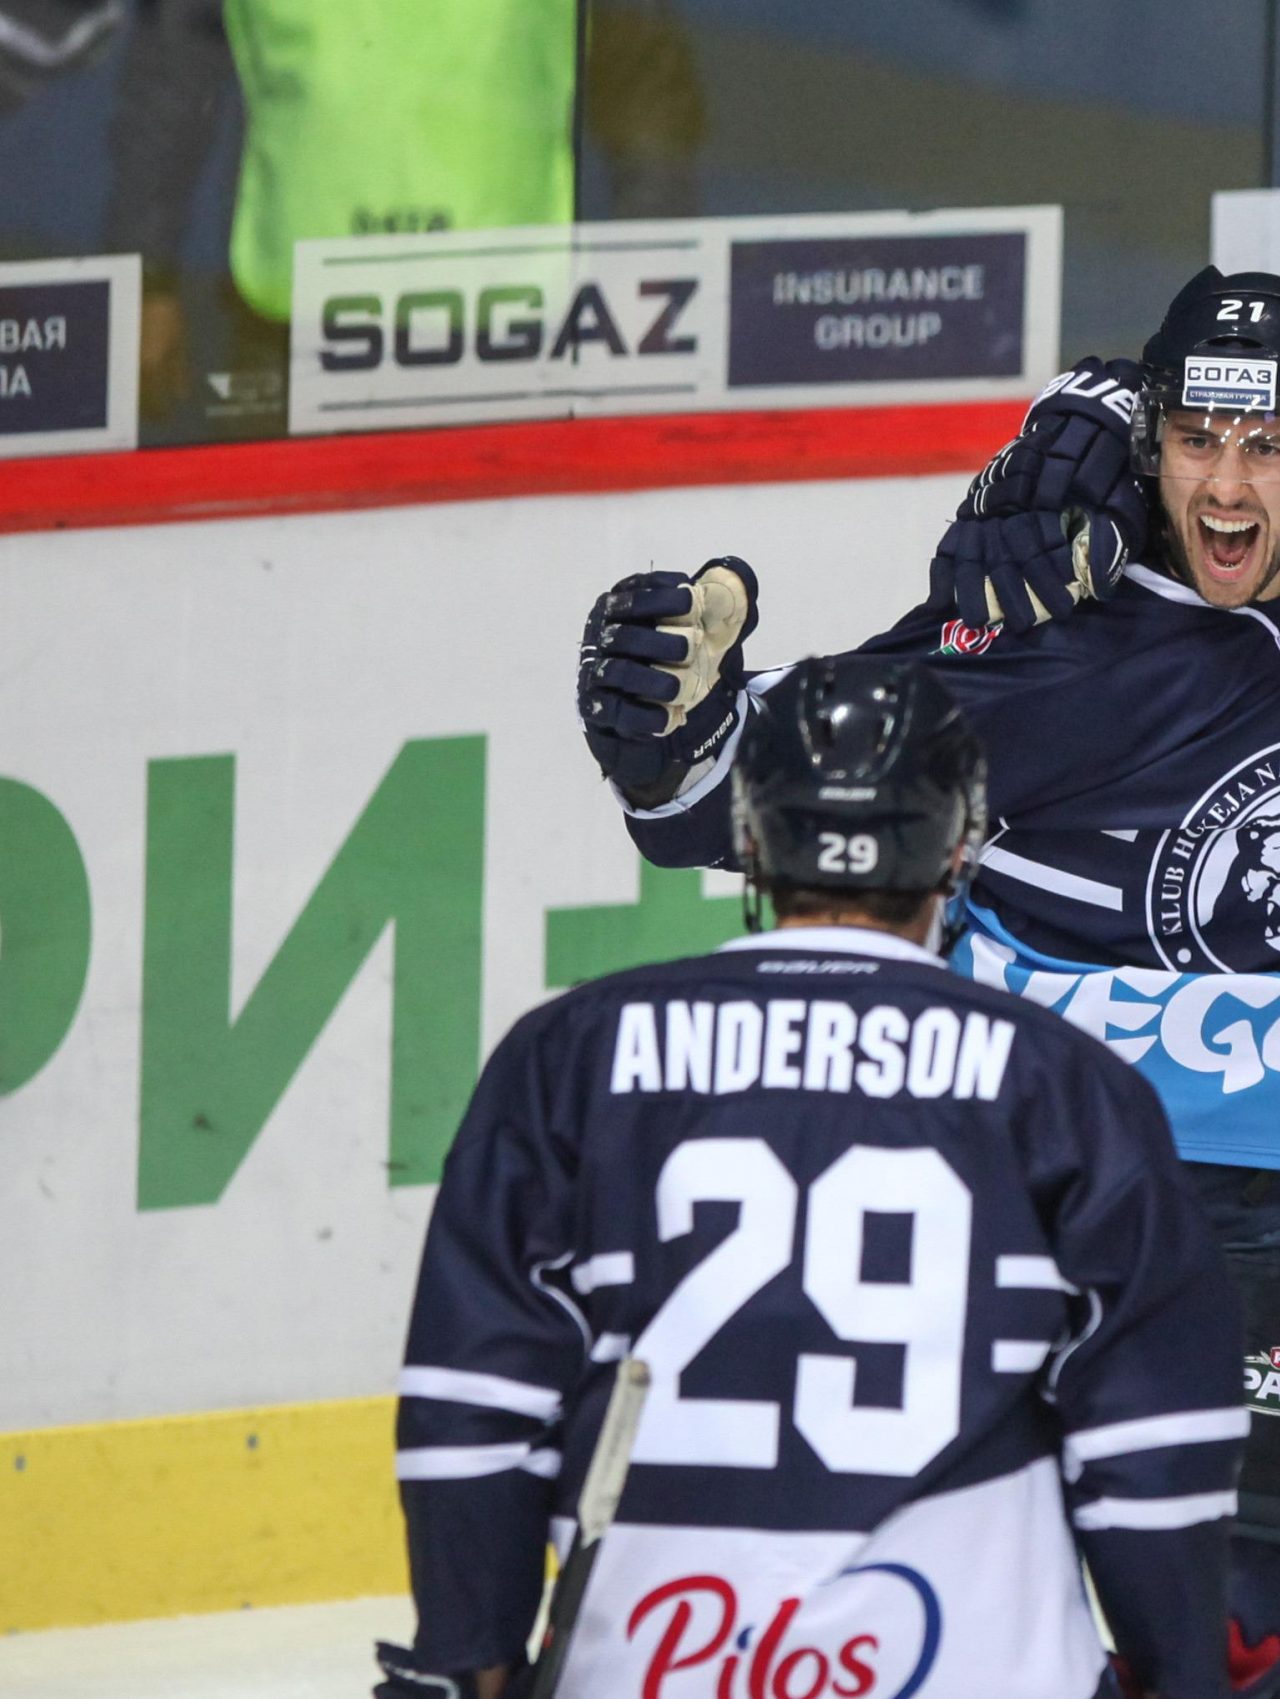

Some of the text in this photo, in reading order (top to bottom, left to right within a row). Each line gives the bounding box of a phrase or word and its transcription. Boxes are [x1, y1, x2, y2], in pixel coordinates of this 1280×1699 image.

[773, 265, 984, 304] INSURANCE
[1216, 299, 1265, 322] 21
[319, 279, 699, 371] SOGAZ
[814, 312, 942, 349] GROUP
[1188, 367, 1272, 384] СОГАЗ
[817, 832, 879, 874] 29
[1161, 866, 1185, 936] KLUB
[610, 999, 1016, 1101] ANDERSON
[628, 1137, 973, 1478] 29
[627, 1575, 878, 1699] Pilos
